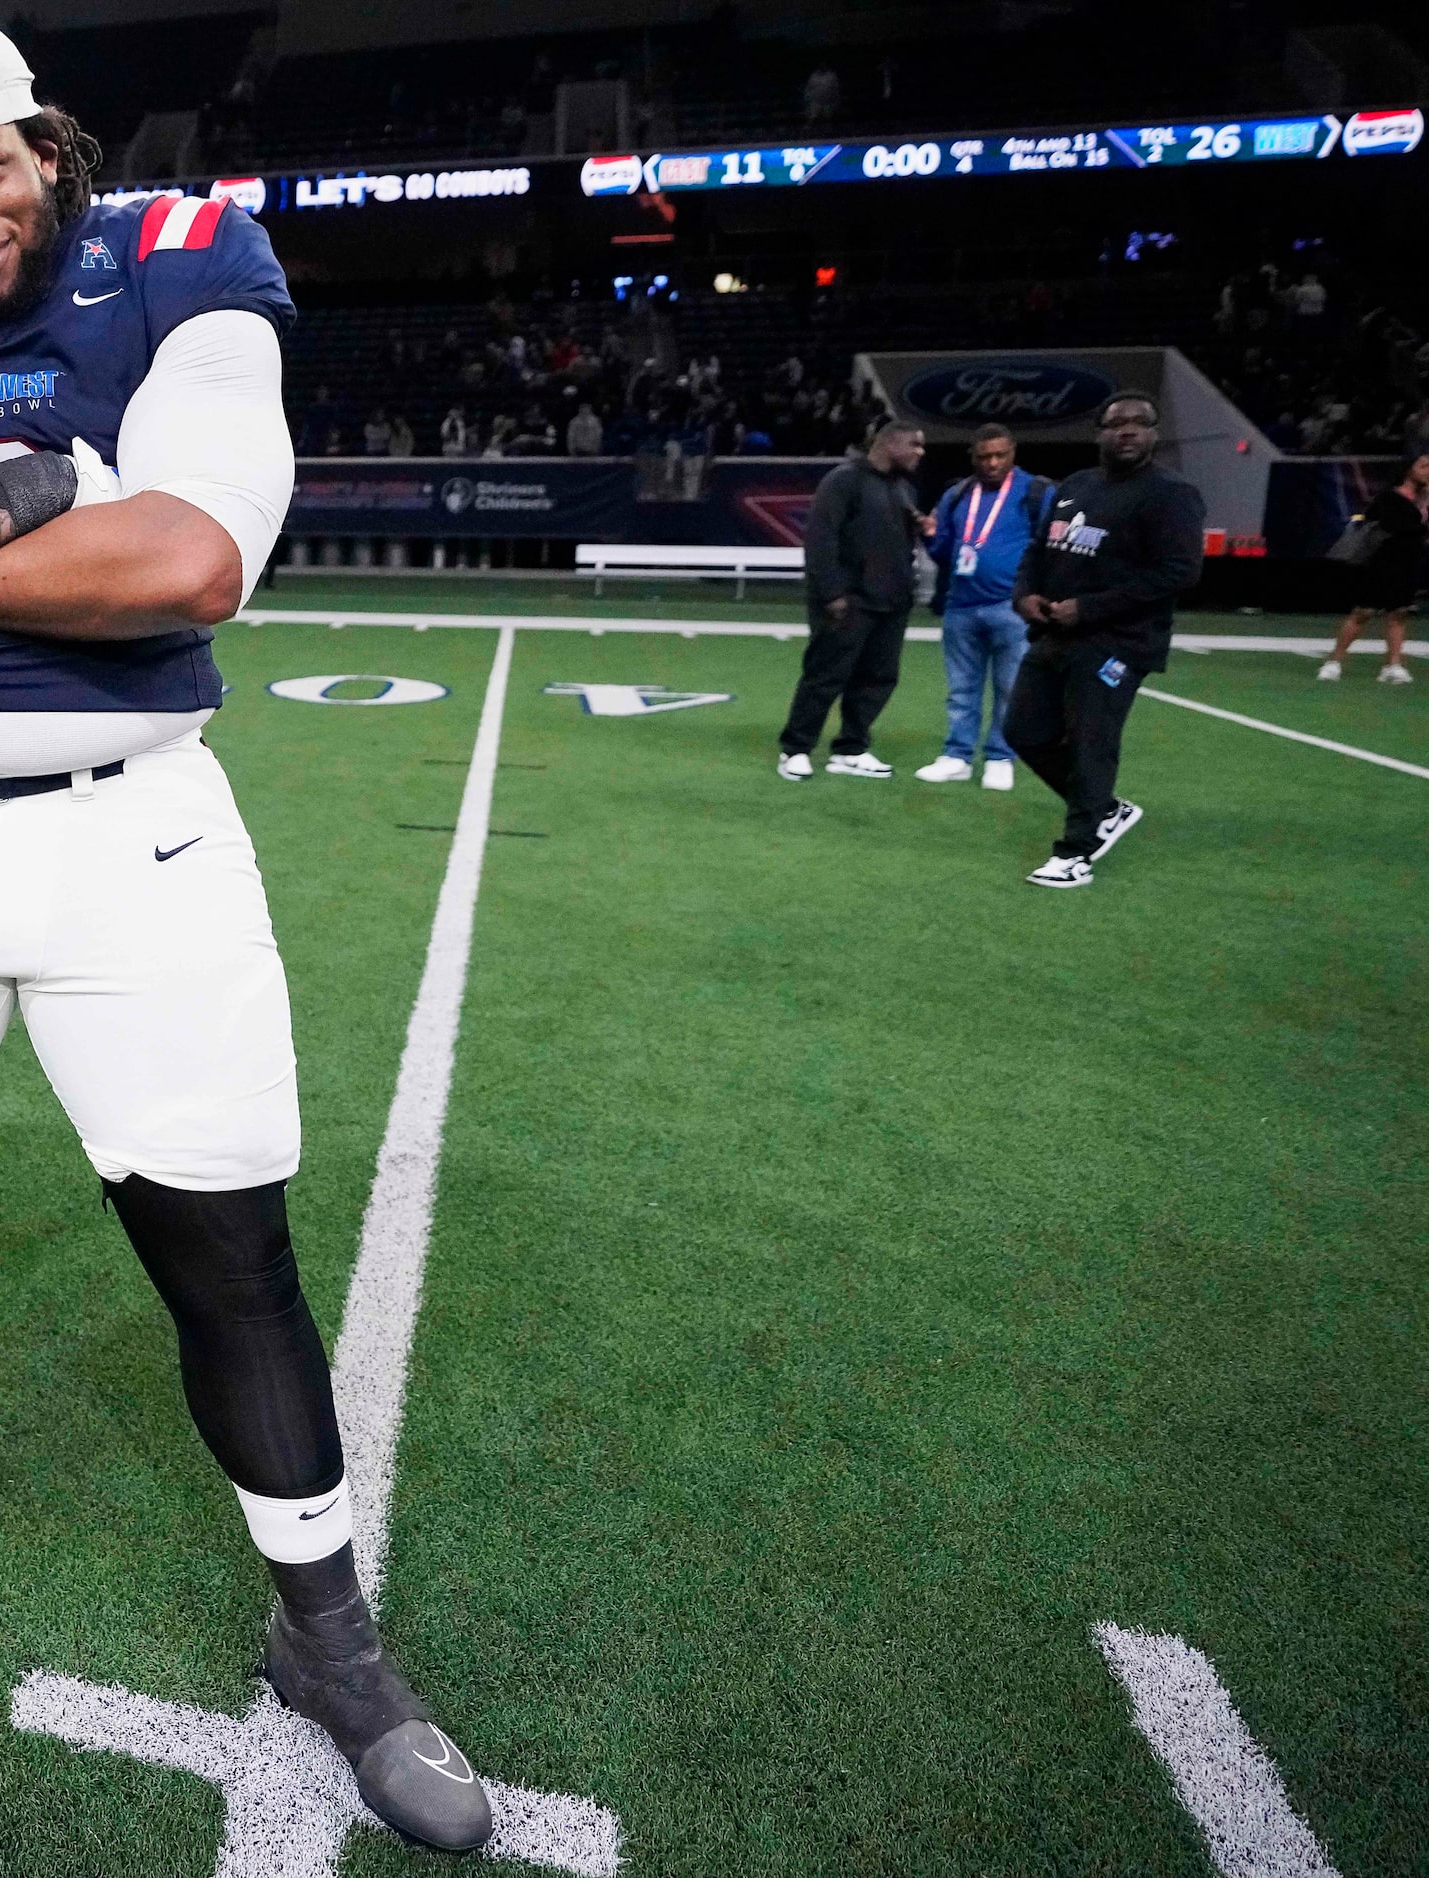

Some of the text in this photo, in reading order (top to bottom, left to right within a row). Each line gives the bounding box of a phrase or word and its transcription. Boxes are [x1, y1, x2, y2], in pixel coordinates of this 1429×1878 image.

[1186, 124, 1241, 161] 26
[1351, 124, 1415, 139] PEPSI
[720, 151, 765, 185] 11
[862, 143, 941, 178] 0:00
[955, 155, 973, 174] 4
[1146, 145, 1164, 164] 2
[296, 168, 530, 206] LET'S GO COWBOYS
[940, 369, 1076, 416] Ford
